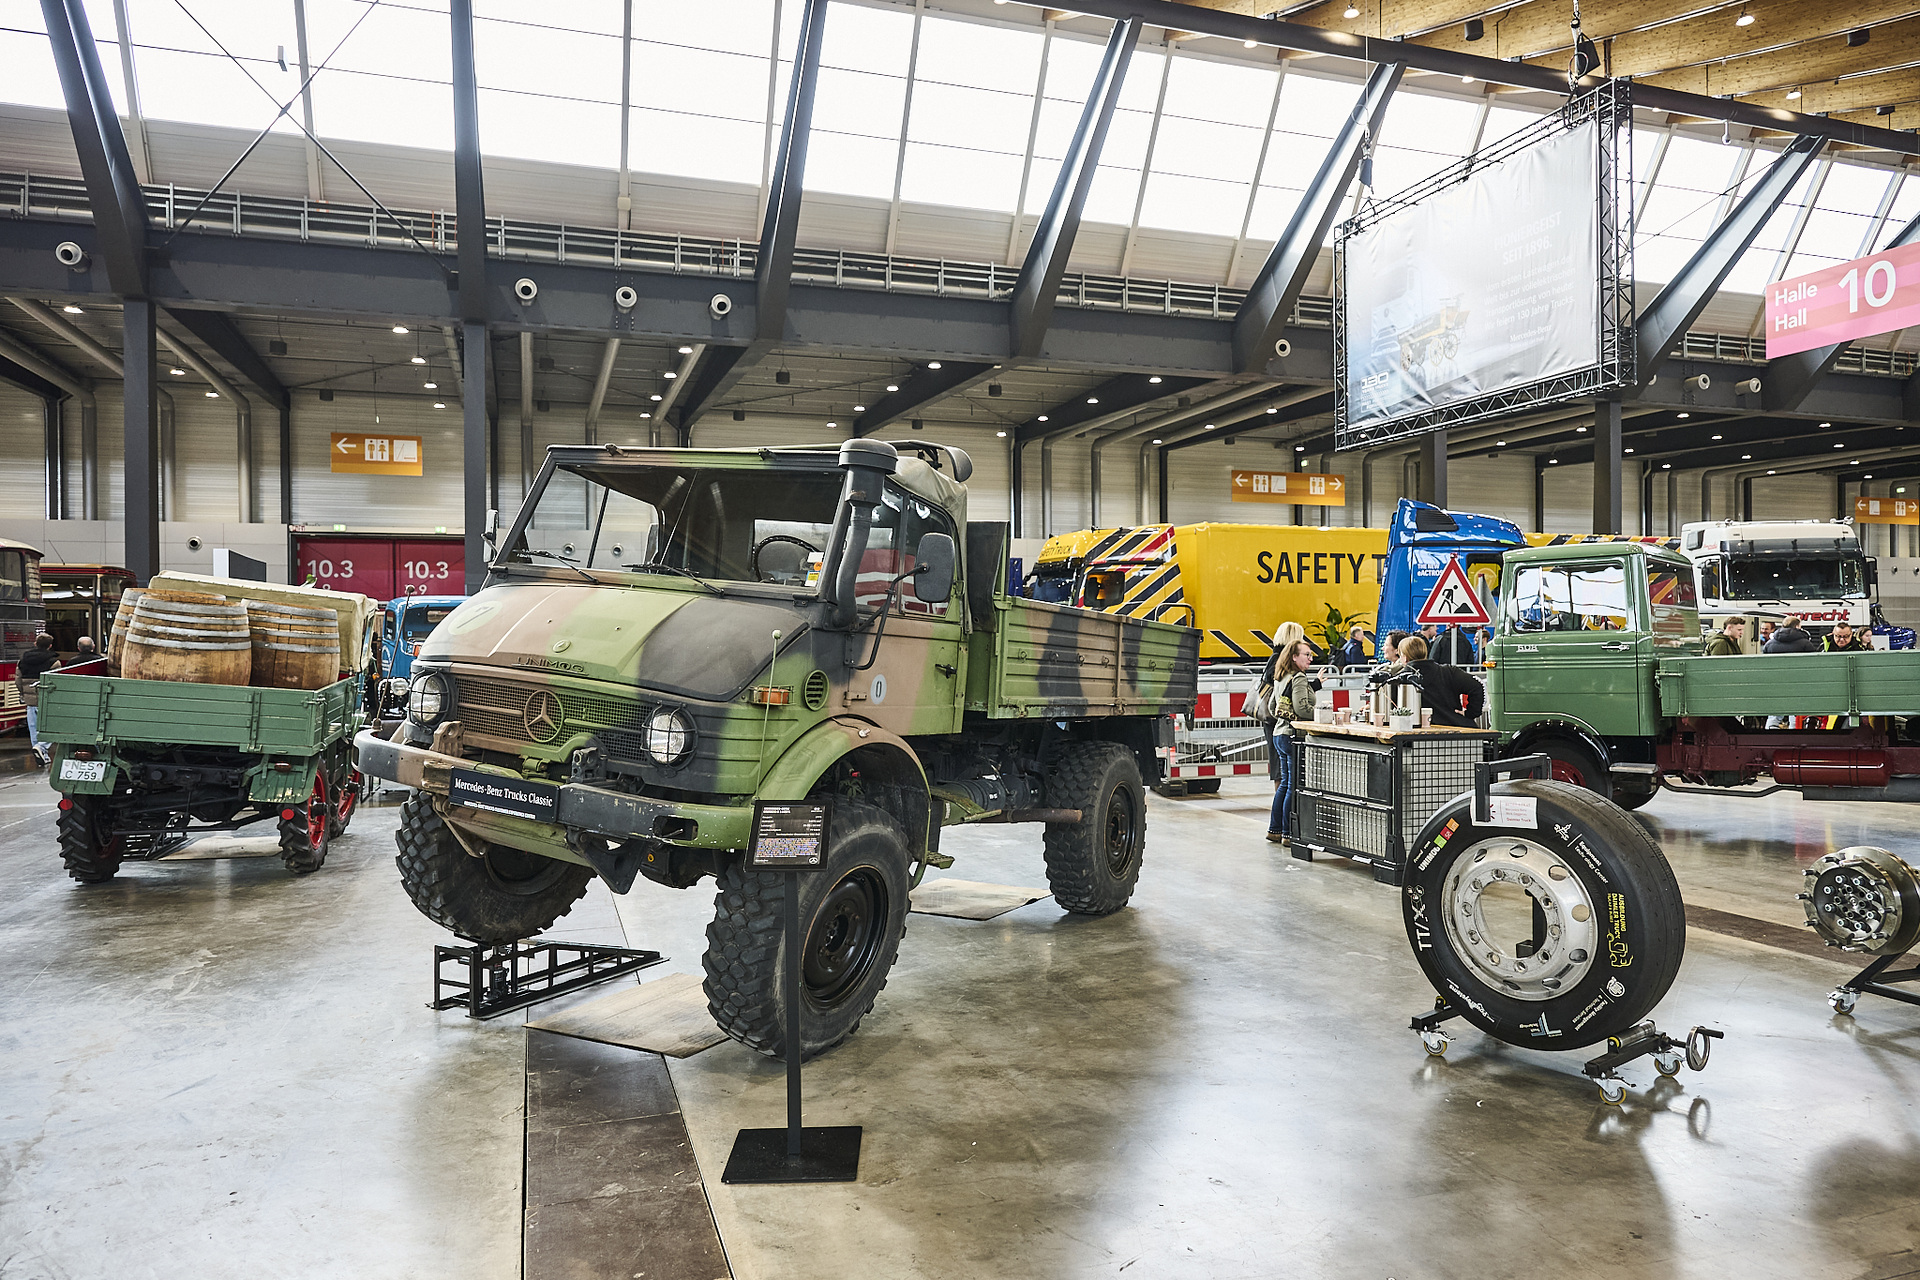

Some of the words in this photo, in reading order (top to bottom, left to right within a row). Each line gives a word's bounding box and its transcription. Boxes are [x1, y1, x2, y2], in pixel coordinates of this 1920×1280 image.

[1494, 211, 1562, 251] PIONIERGEIST
[1503, 246, 1523, 265] SEIT
[1775, 282, 1818, 306] Halle
[1838, 260, 1897, 314] 10
[1517, 308, 1530, 320] 130
[1531, 304, 1549, 317] Jahre
[1775, 308, 1807, 332] Hall
[1361, 371, 1389, 389] 130
[307, 559, 354, 578] 10.3
[404, 561, 449, 579] 10.3
[1256, 551, 1365, 584] SAFETY
[517, 657, 585, 673] UNIMOG
[65, 770, 72, 779] C
[77, 771, 97, 780] 759
[71, 761, 95, 771] NES
[454, 778, 502, 797] Mercedes-Benz
[504, 788, 527, 803] Trucks
[529, 793, 553, 807] Classic
